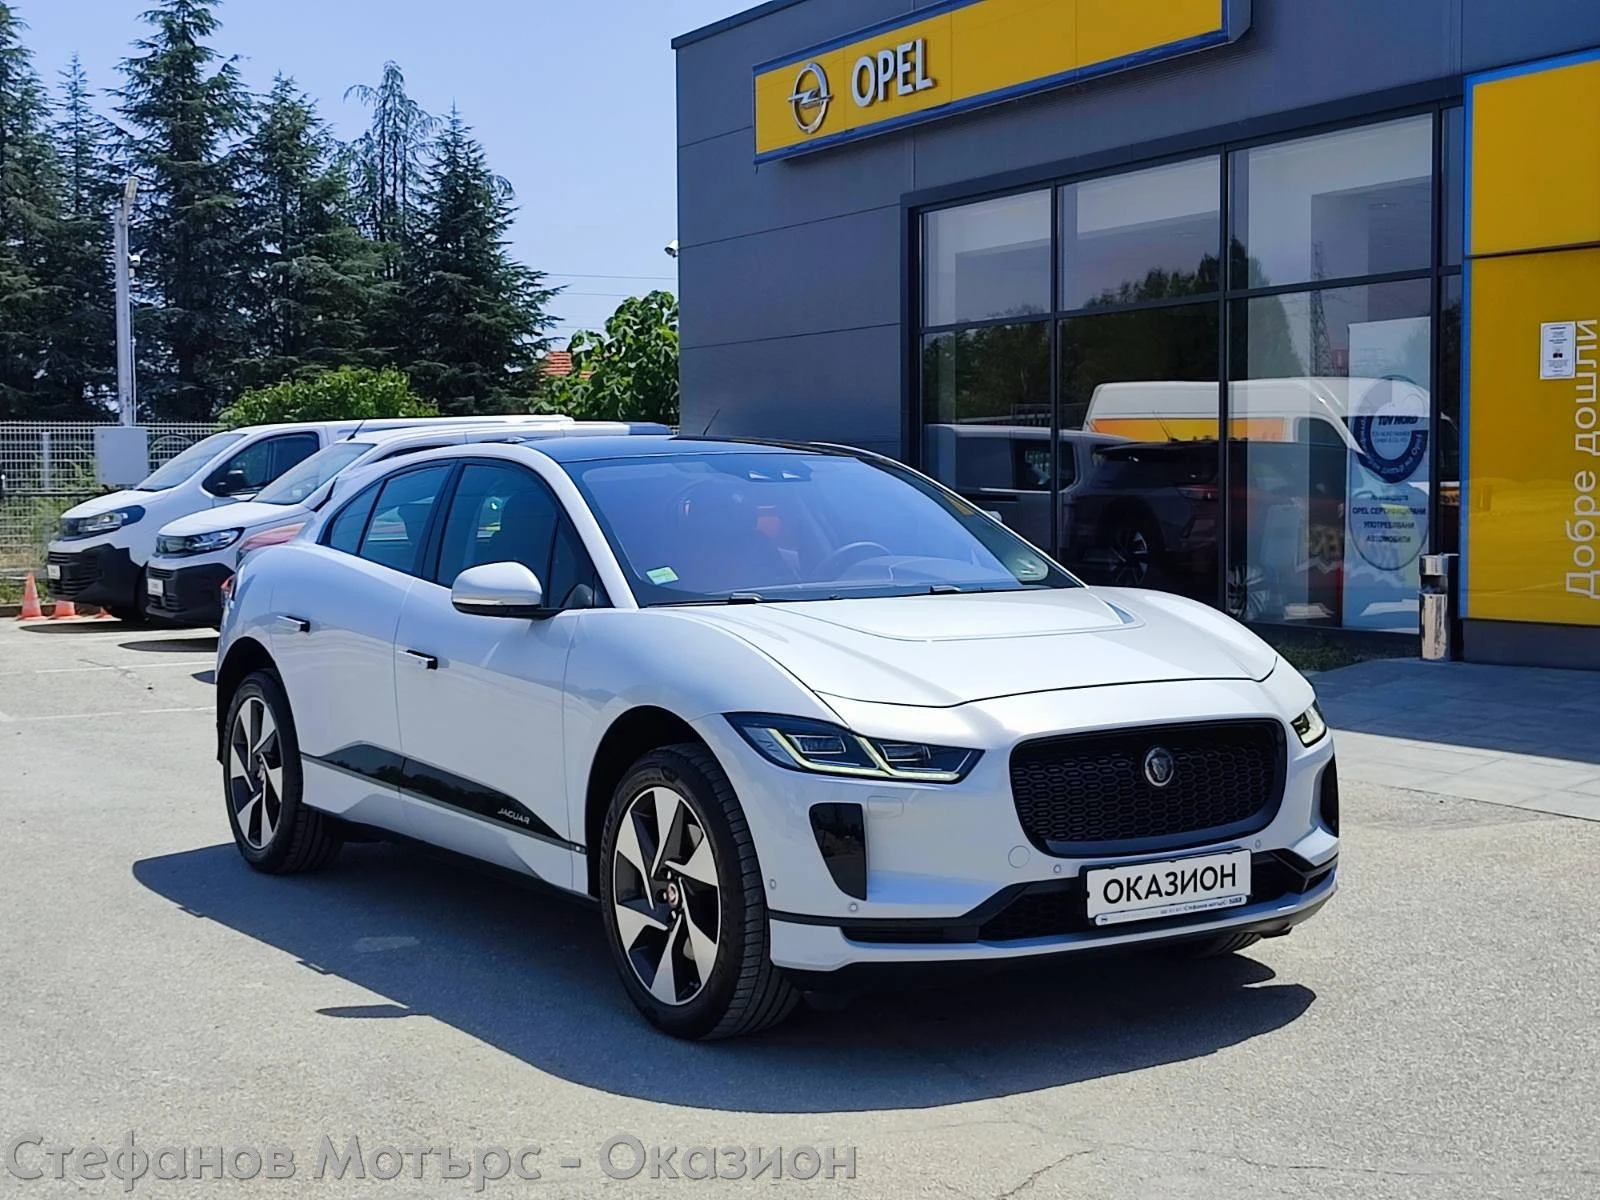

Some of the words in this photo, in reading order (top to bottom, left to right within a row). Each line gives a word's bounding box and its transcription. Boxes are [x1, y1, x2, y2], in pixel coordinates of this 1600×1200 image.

[851, 37, 936, 108] OPEL
[1574, 319, 1600, 456] дошли
[1565, 470, 1600, 600] Добре
[497, 807, 530, 825] JAGUAR
[1103, 862, 1236, 904] ОКАЗИОН
